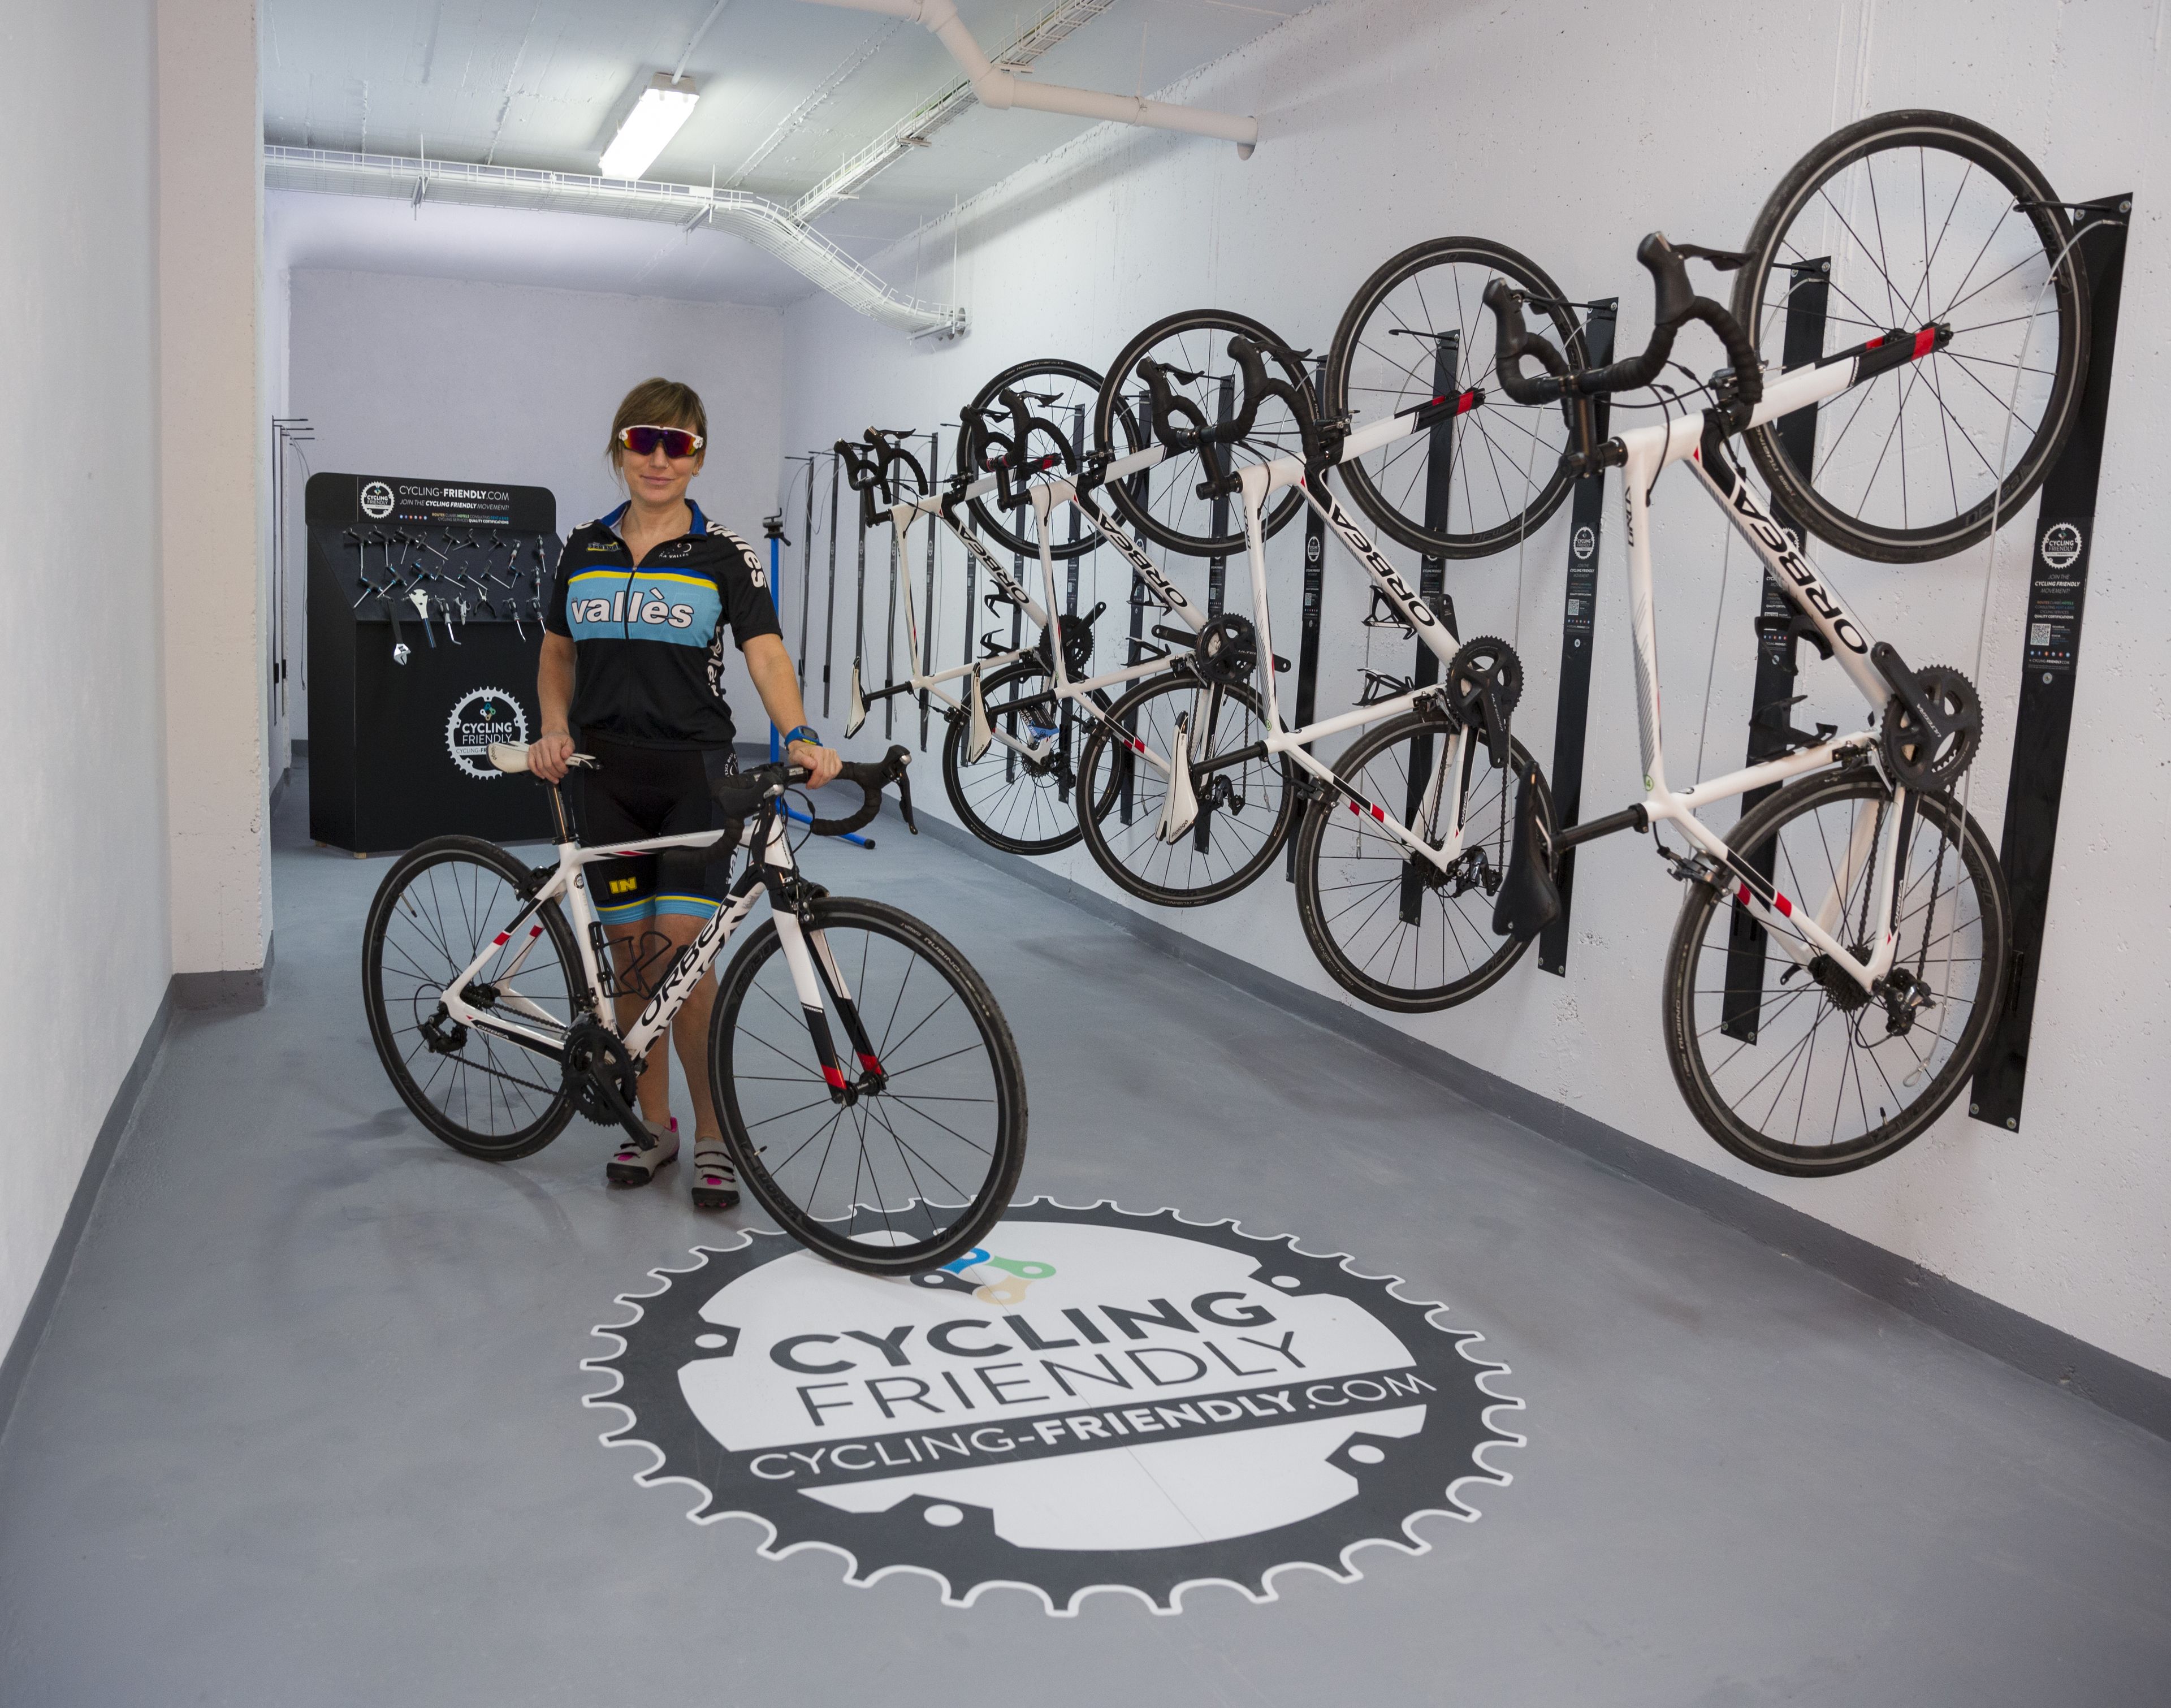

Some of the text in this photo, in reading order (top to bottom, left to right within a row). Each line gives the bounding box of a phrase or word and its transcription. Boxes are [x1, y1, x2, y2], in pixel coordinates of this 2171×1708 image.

[399, 485, 509, 501] CYCLING-FRIENDLY.COM
[959, 525, 1030, 604] ORBEA
[1100, 513, 1188, 607] ORBEA
[1331, 507, 1435, 626] ORBEA
[1733, 485, 1869, 654] ORBEA
[571, 587, 694, 629] vallès
[462, 722, 512, 734] CYCLING
[462, 733, 512, 745] FRIENDLY
[609, 876, 637, 894] IN
[1894, 880, 1904, 927] ORBEA
[641, 897, 738, 1027] ORBEA
[924, 937, 961, 973] RUBINO
[477, 1024, 509, 1040] ORBEA
[769, 1290, 1278, 1376] CYCLING
[795, 1329, 1311, 1429] FRIENDLY
[747, 1371, 1438, 1482] CYCLING-FRIENDLY.COM
